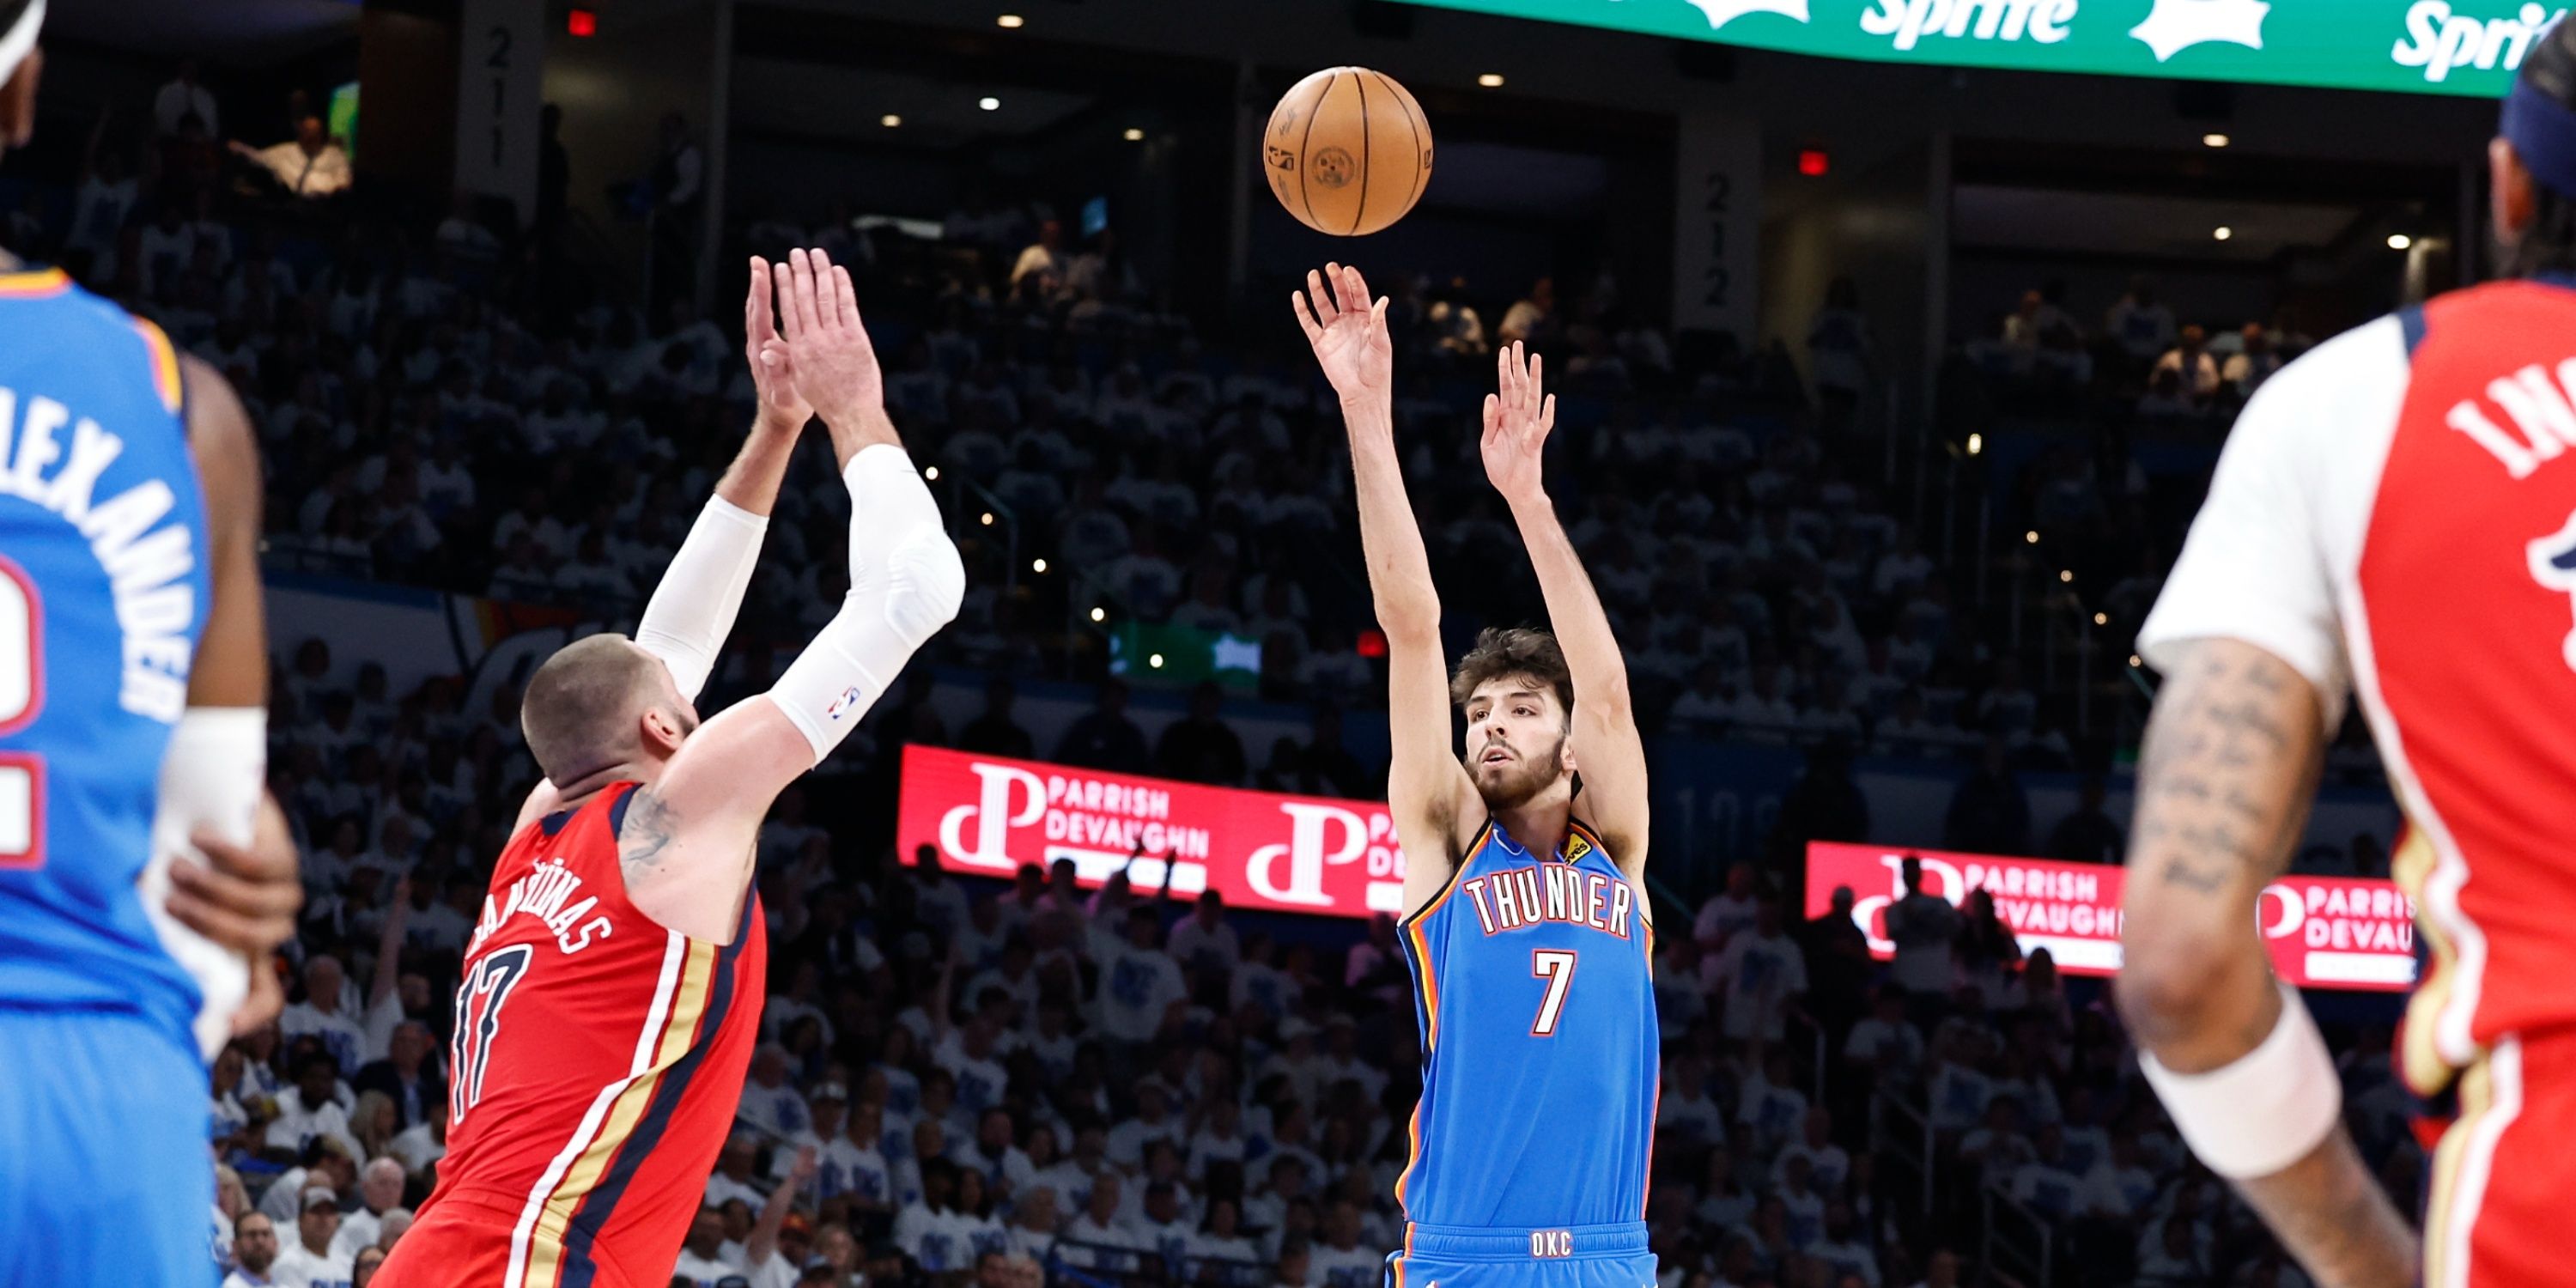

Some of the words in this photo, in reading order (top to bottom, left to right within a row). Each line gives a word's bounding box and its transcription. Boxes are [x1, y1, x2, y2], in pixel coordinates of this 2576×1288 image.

[1048, 776, 1170, 820] PARRISH
[1045, 809, 1209, 859] DEVAUGHN
[1461, 861, 1632, 941] THUNDER
[1965, 864, 2098, 902] PARRISH
[1994, 897, 2124, 937] VAUGH
[1530, 948, 1578, 1037] 7
[453, 943, 533, 1127] 17
[1530, 1230, 1573, 1259] OKC
